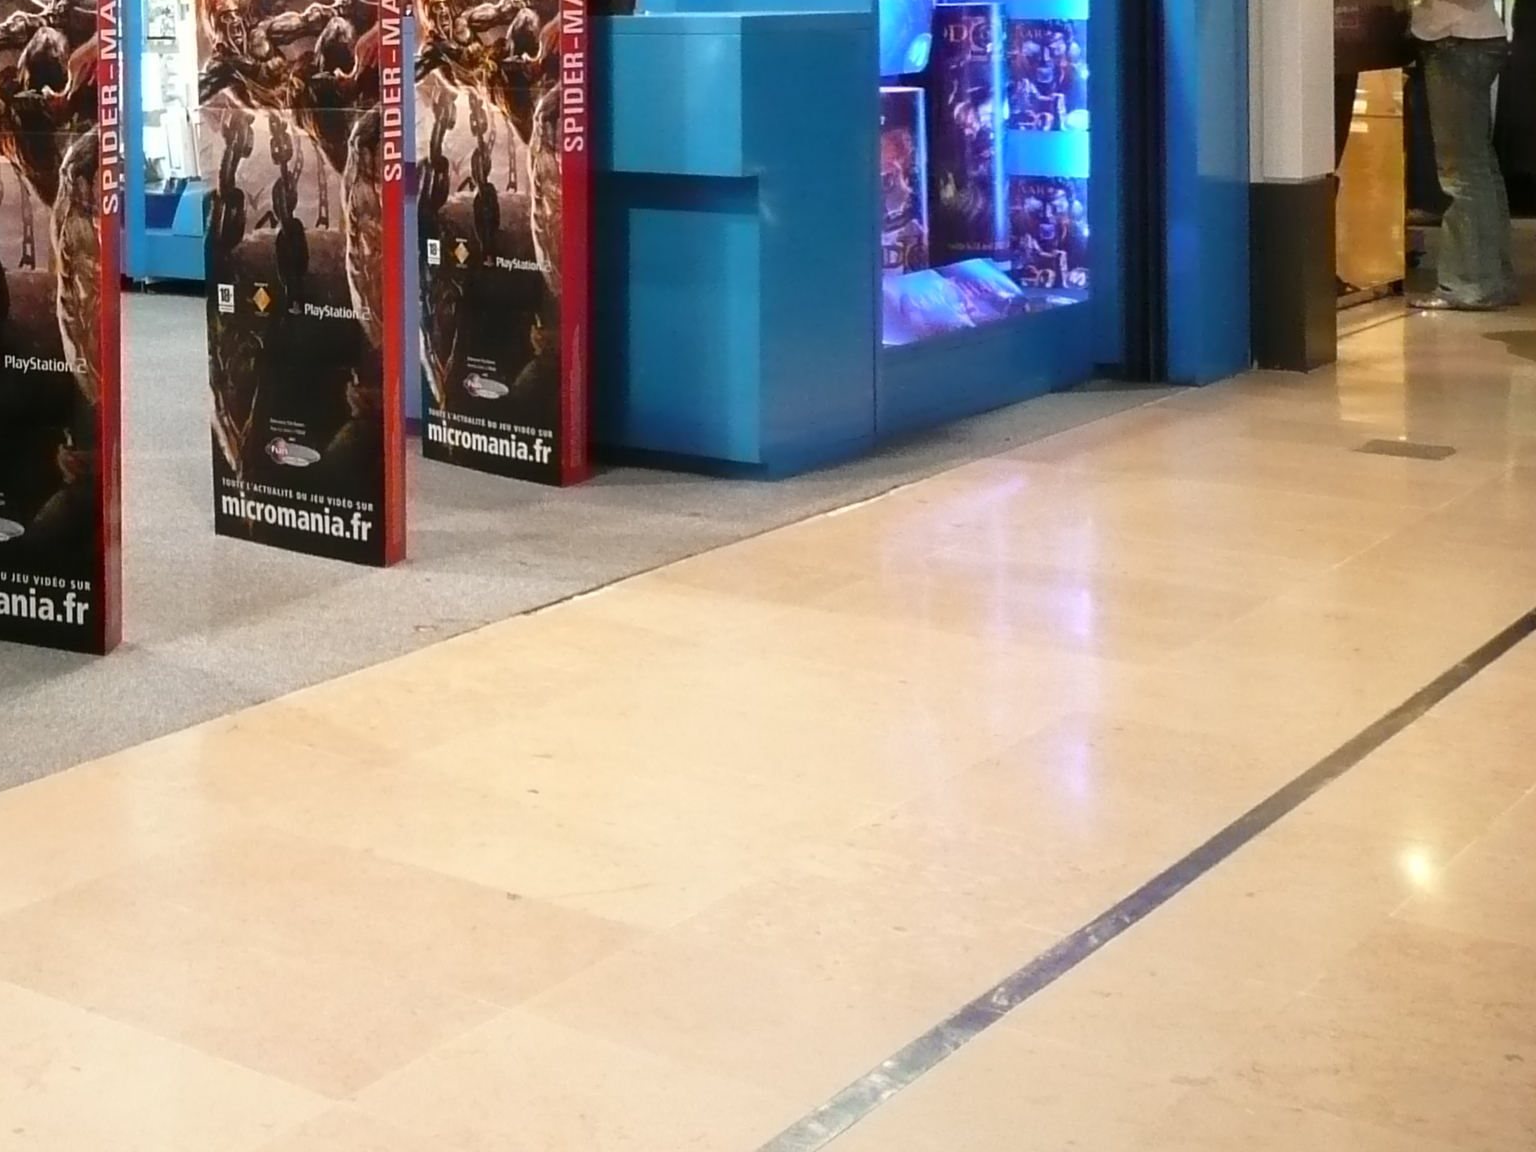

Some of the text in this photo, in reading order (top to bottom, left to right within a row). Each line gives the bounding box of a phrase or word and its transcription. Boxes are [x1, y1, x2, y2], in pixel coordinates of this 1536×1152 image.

[496, 256, 541, 272] PlayStation
[304, 303, 359, 320] PlayStation
[4, 355, 87, 374] PlayStation 2
[499, 422, 512, 432] JEU
[538, 429, 553, 438] SUR
[428, 419, 552, 464] micromania.fr
[222, 477, 374, 512] TOUTE L'ACTUALITÉ DU JEU VIDÉO SUR
[221, 491, 372, 542] micromania.fr
[11, 573, 29, 584] JEU
[33, 575, 66, 588] VIDÉO
[70, 580, 91, 591] SUR
